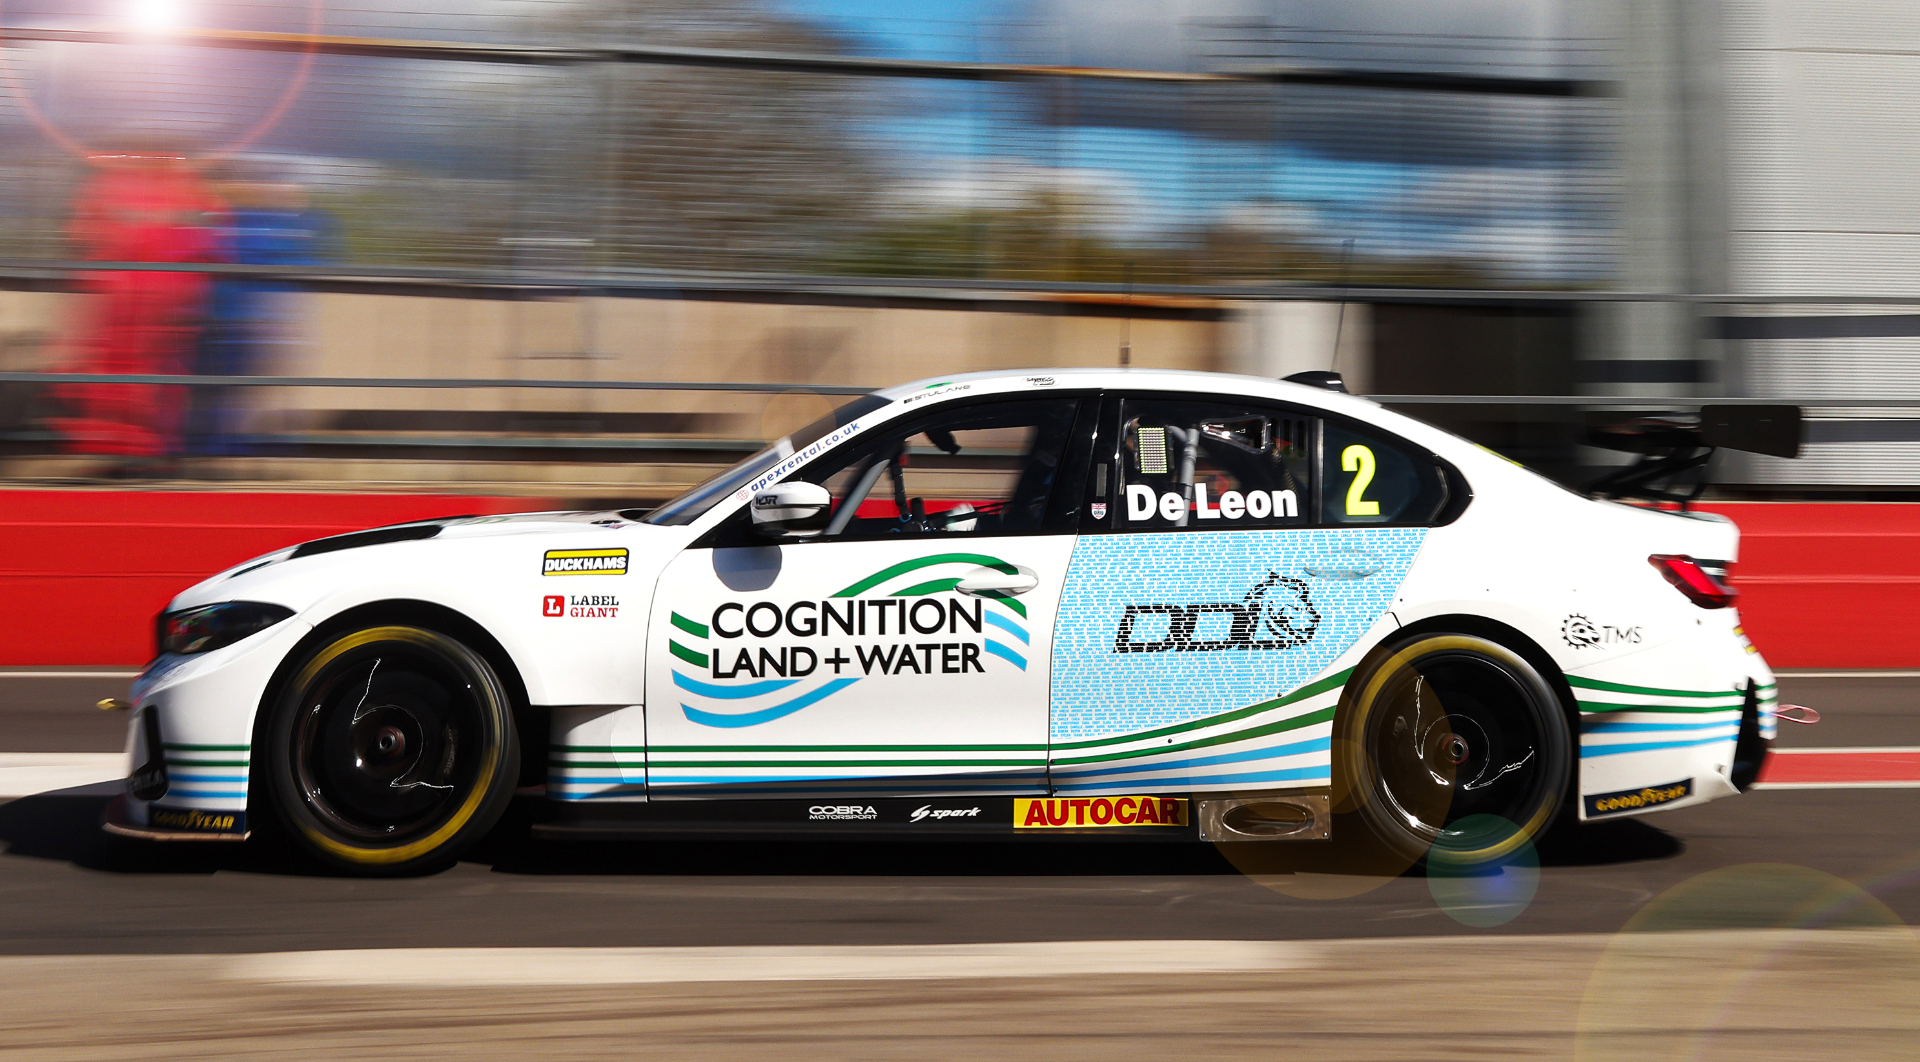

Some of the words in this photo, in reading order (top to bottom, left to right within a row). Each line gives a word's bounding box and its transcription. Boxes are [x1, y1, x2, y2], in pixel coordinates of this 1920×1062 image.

[751, 421, 860, 492] apexrental.co.uk
[1341, 444, 1380, 516] 2
[1126, 484, 1185, 521] De
[1195, 483, 1298, 519] Leon
[545, 556, 627, 572] DUCKHAMS
[570, 595, 620, 606] LABEL
[570, 607, 619, 618] GIANT
[711, 599, 982, 639] COGNITION
[1602, 626, 1643, 643] TMS
[712, 646, 818, 679] LAND
[854, 642, 986, 676] WATER
[808, 805, 878, 814] COBRA
[1024, 797, 1180, 827] AUTOCAR
